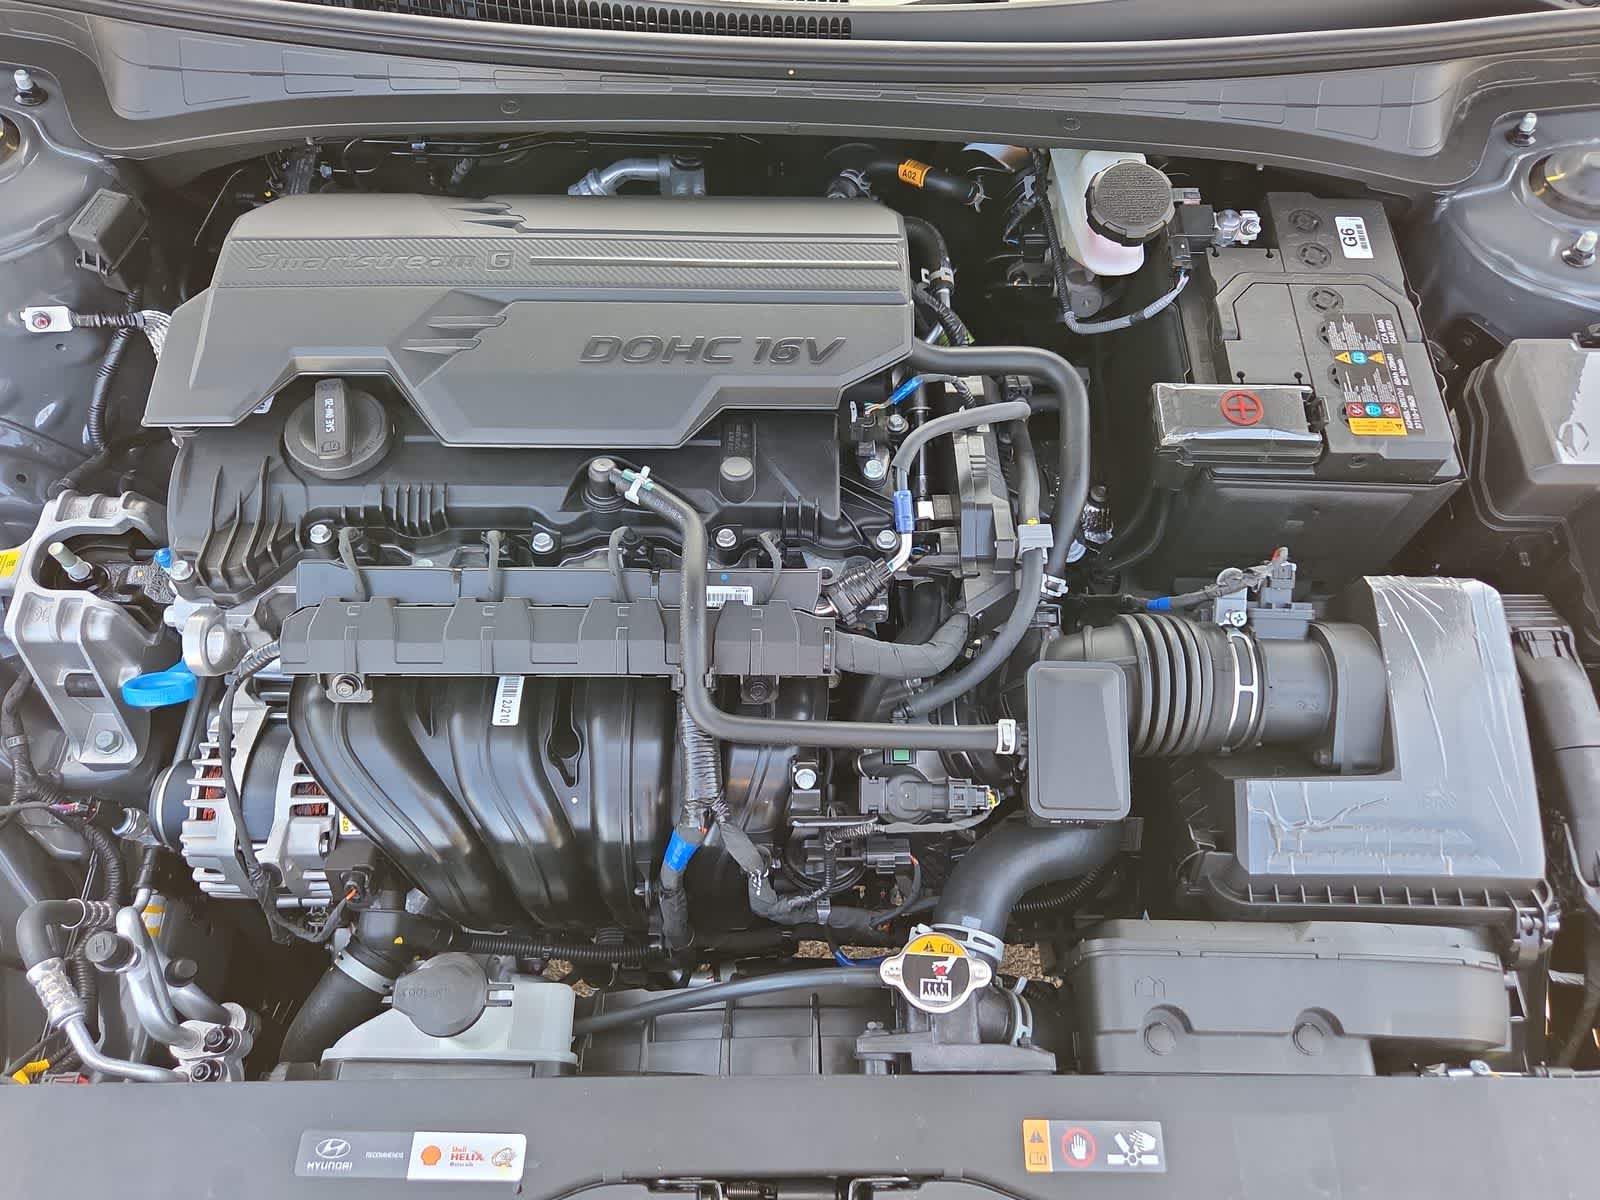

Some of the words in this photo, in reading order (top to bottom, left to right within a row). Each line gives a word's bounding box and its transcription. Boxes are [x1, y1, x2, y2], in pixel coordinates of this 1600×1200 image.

[902, 169, 916, 181] A02
[1340, 228, 1358, 247] G6
[248, 252, 478, 271] Smartstream
[578, 335, 743, 363] DOHC
[752, 336, 848, 364] 16V
[325, 418, 335, 433] SAE
[450, 1152, 483, 1161] HELIX
[307, 1161, 353, 1170] HYUNDAI
